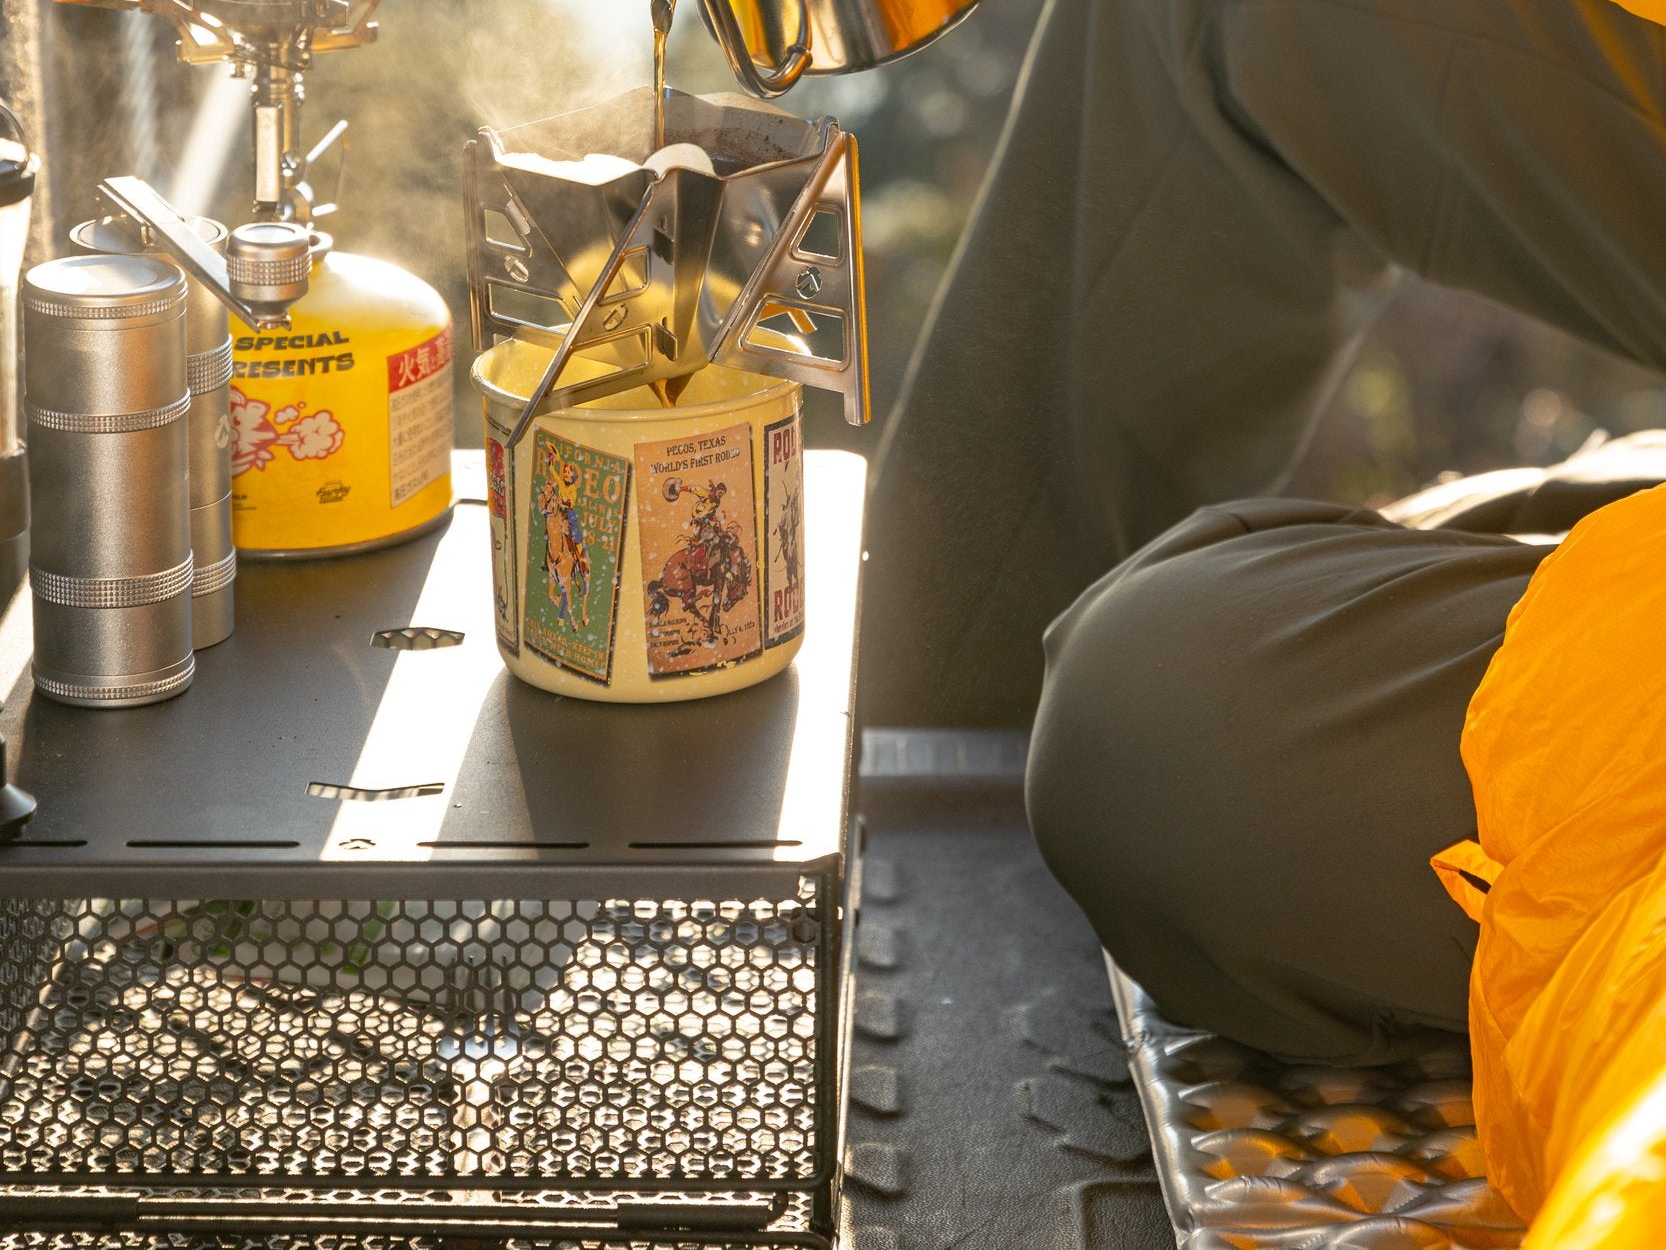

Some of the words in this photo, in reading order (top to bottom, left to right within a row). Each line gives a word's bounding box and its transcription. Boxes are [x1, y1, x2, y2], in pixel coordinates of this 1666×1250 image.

[235, 331, 350, 351] SPECIAL
[232, 353, 355, 379] RESENTS
[666, 442, 697, 457] PECOS,
[698, 435, 726, 452] TEXAS
[650, 459, 689, 475] WORLD'S
[690, 454, 714, 469] FIRST
[715, 447, 741, 462] RODEO
